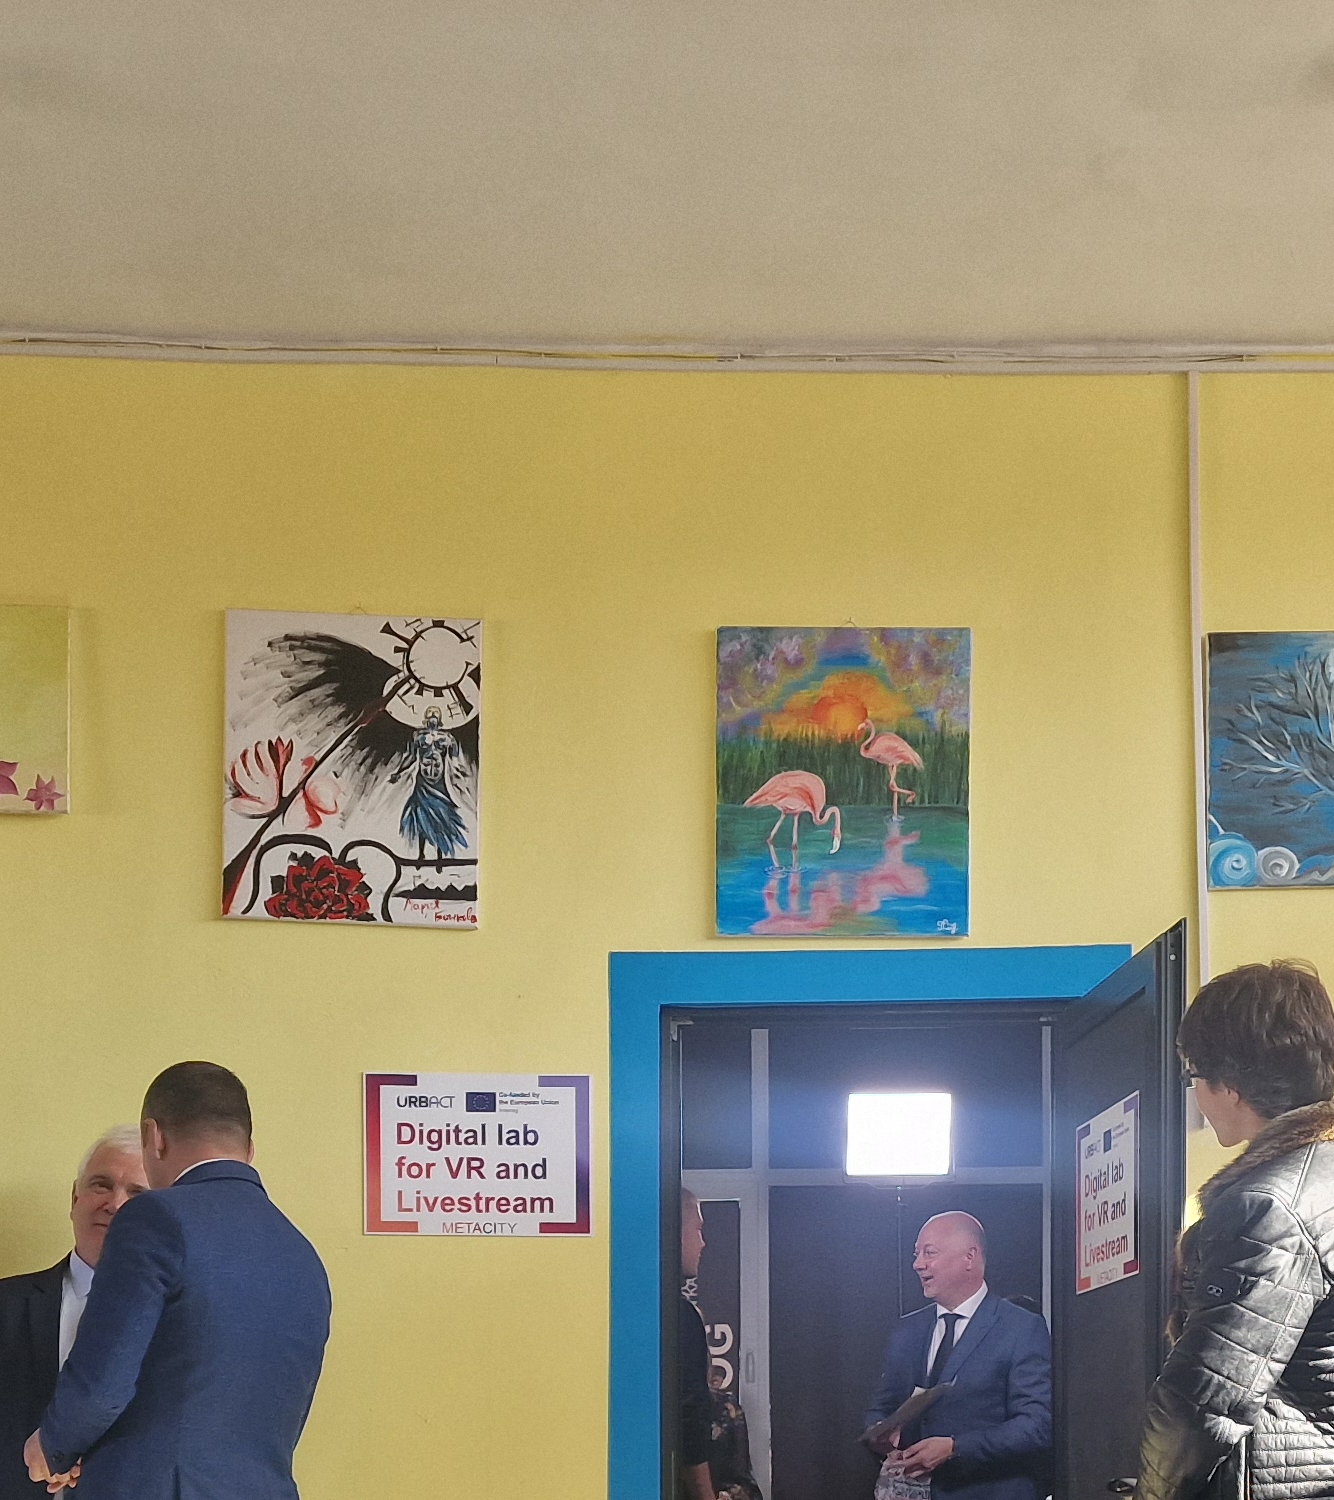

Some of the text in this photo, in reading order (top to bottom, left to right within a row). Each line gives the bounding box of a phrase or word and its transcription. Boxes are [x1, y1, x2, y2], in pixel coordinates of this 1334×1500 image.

[396, 1095, 456, 1108] URBACT
[396, 1123, 540, 1151] Digital lab
[395, 1156, 548, 1180] for VR and
[1084, 1157, 1124, 1200] Digital lab
[397, 1190, 554, 1214] Livestream
[1084, 1191, 1127, 1232] for VR and
[442, 1222, 518, 1234] METACITY
[1084, 1233, 1128, 1267] Livestream
